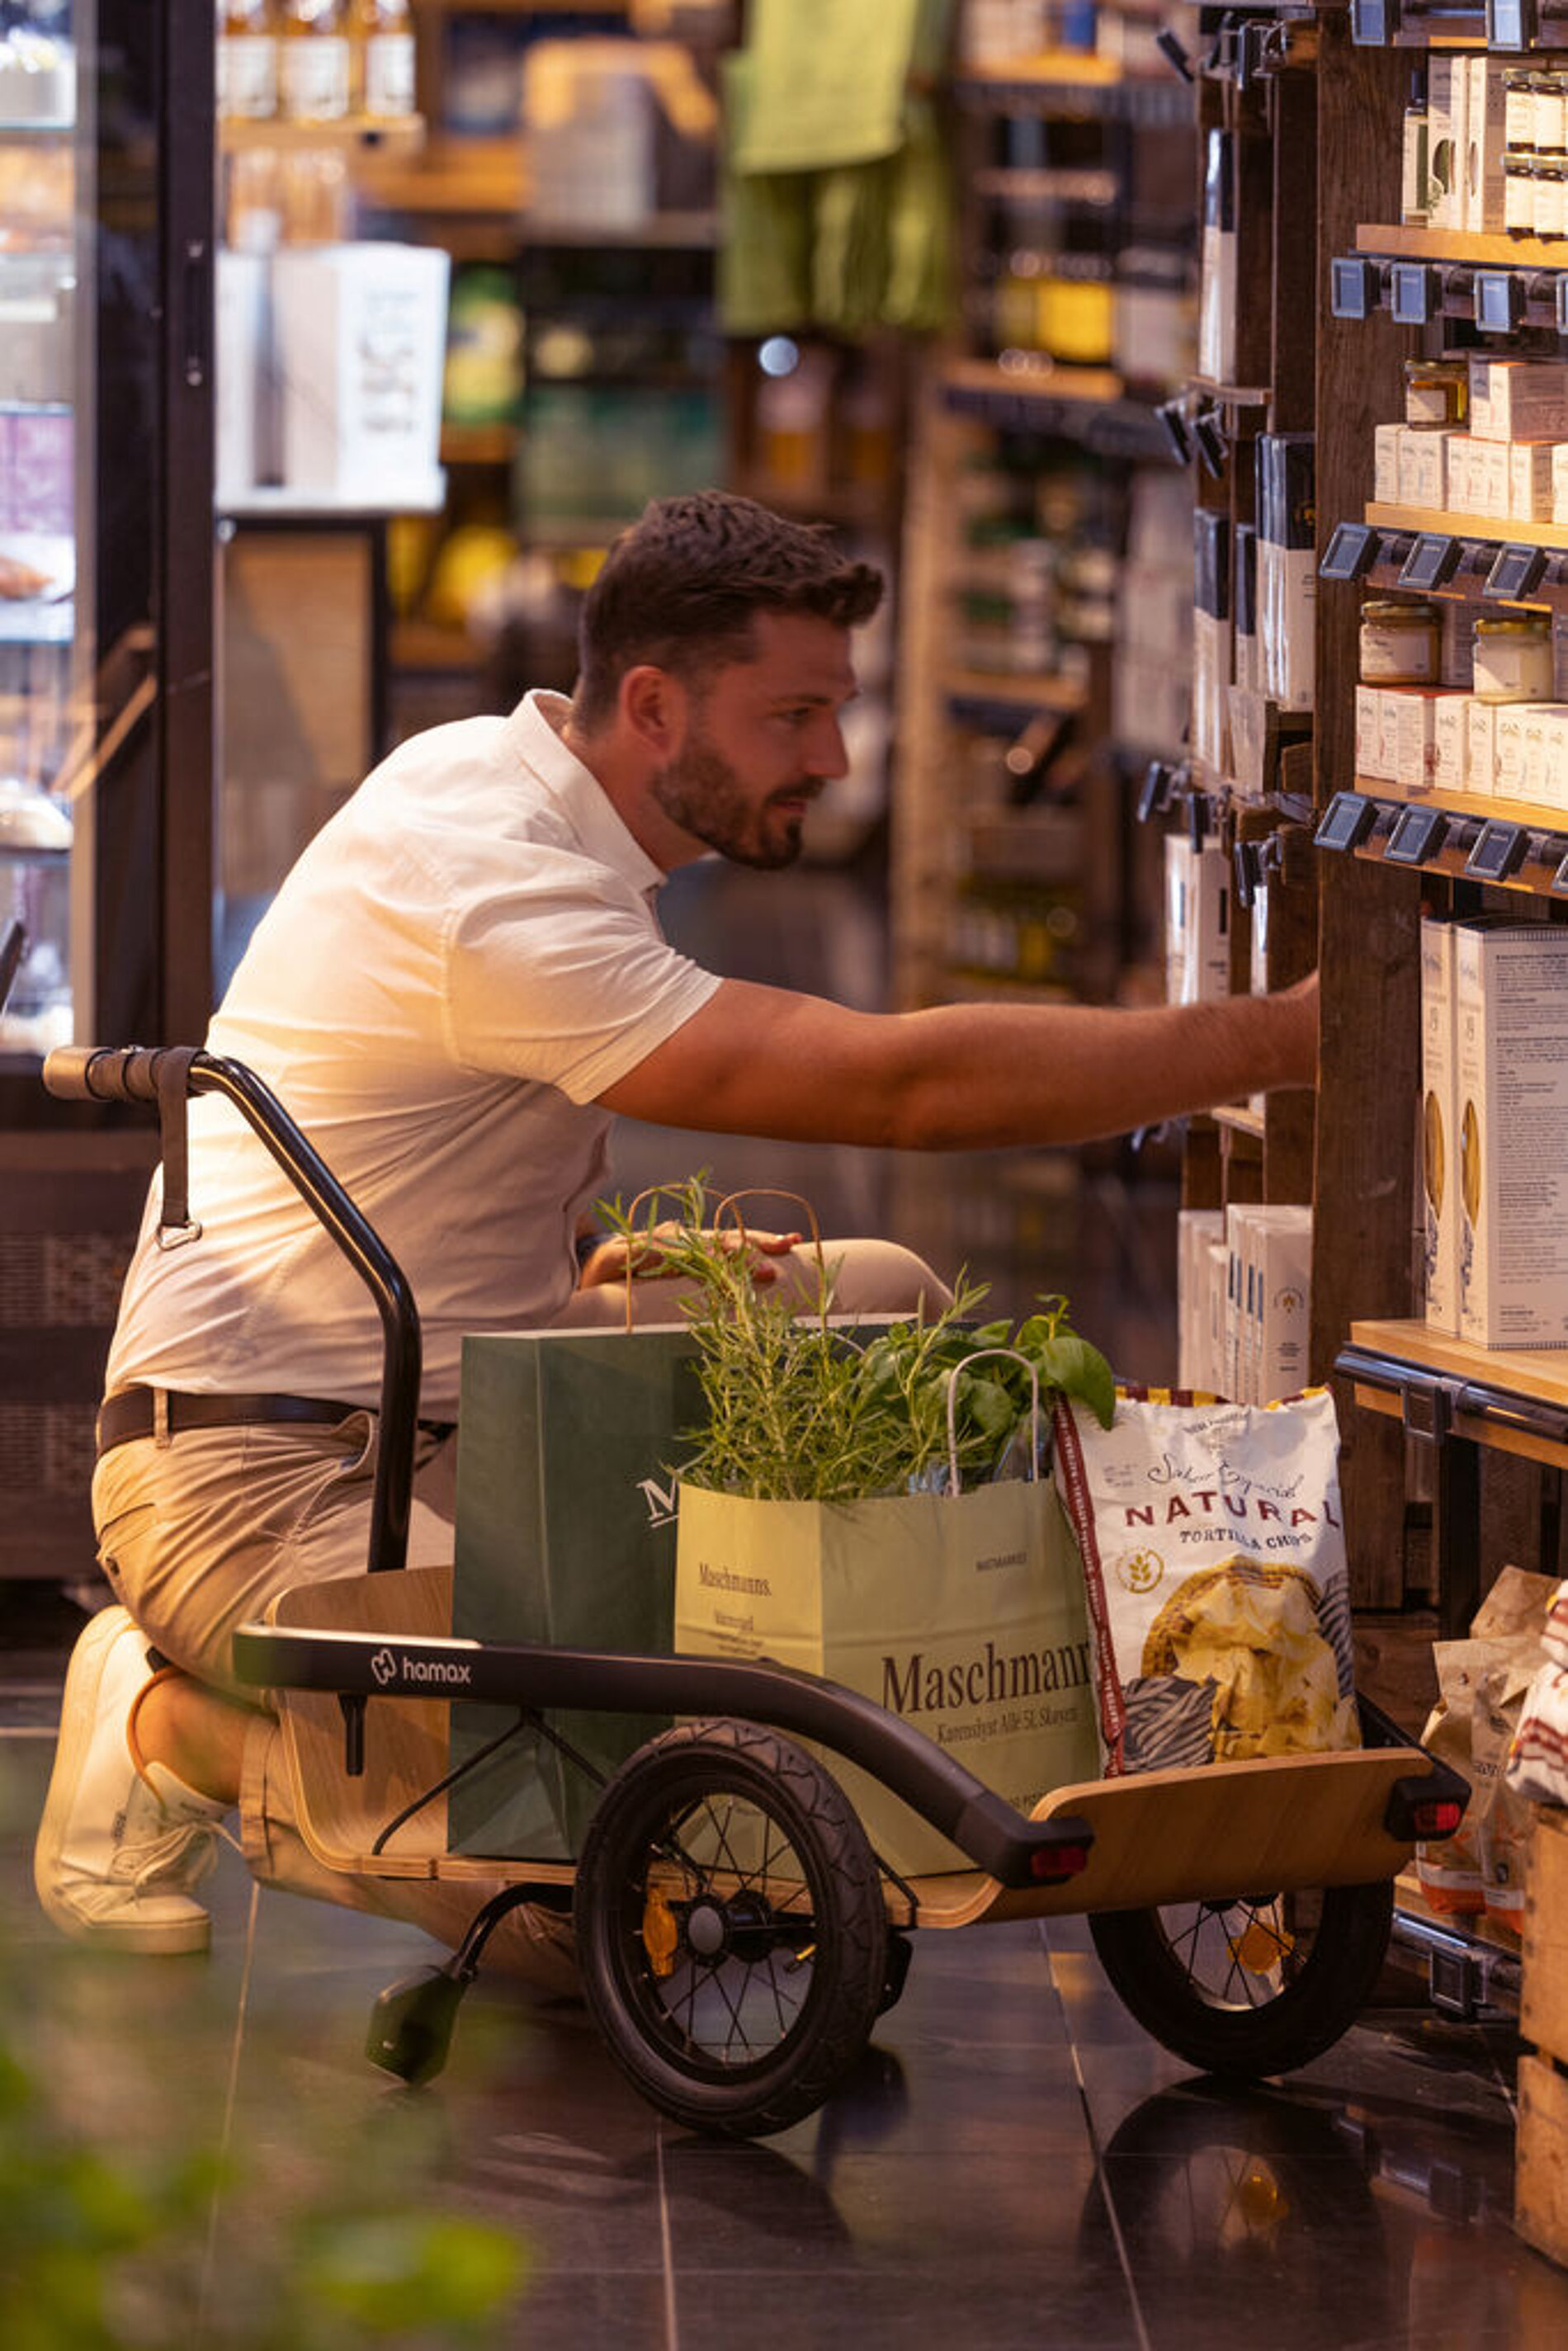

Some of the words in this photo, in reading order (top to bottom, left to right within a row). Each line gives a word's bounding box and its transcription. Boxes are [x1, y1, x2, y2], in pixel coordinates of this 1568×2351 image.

[1125, 1491, 1340, 1528] NATURAL
[1180, 1528, 1262, 1551] TORTILLA
[403, 1655, 471, 1683] hamax
